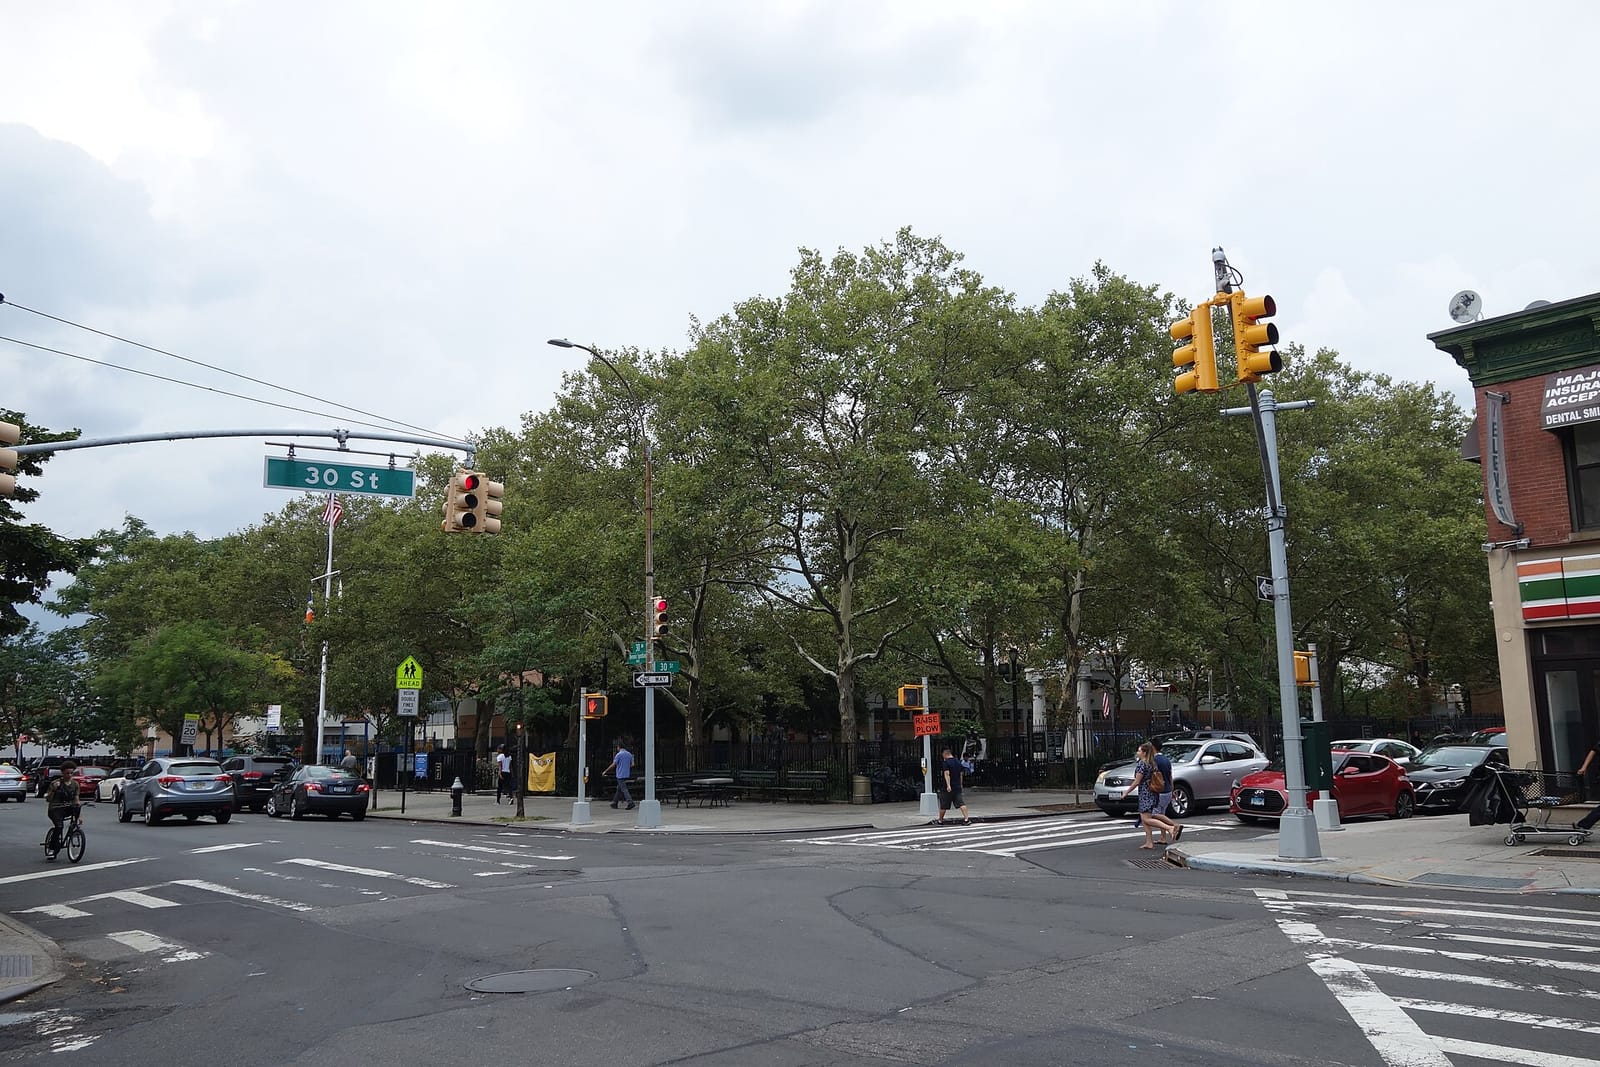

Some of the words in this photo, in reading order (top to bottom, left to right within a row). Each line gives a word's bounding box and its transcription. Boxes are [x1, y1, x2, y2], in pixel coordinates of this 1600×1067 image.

[1556, 371, 1600, 386] MAJ
[1546, 390, 1600, 408] ACCEP
[1545, 410, 1582, 425] DENTAL
[304, 466, 339, 486] 30
[350, 470, 379, 489] St
[660, 662, 667, 671] 30
[915, 715, 938, 725] RAISE
[183, 727, 196, 735] 20
[916, 725, 939, 733] PLOW
